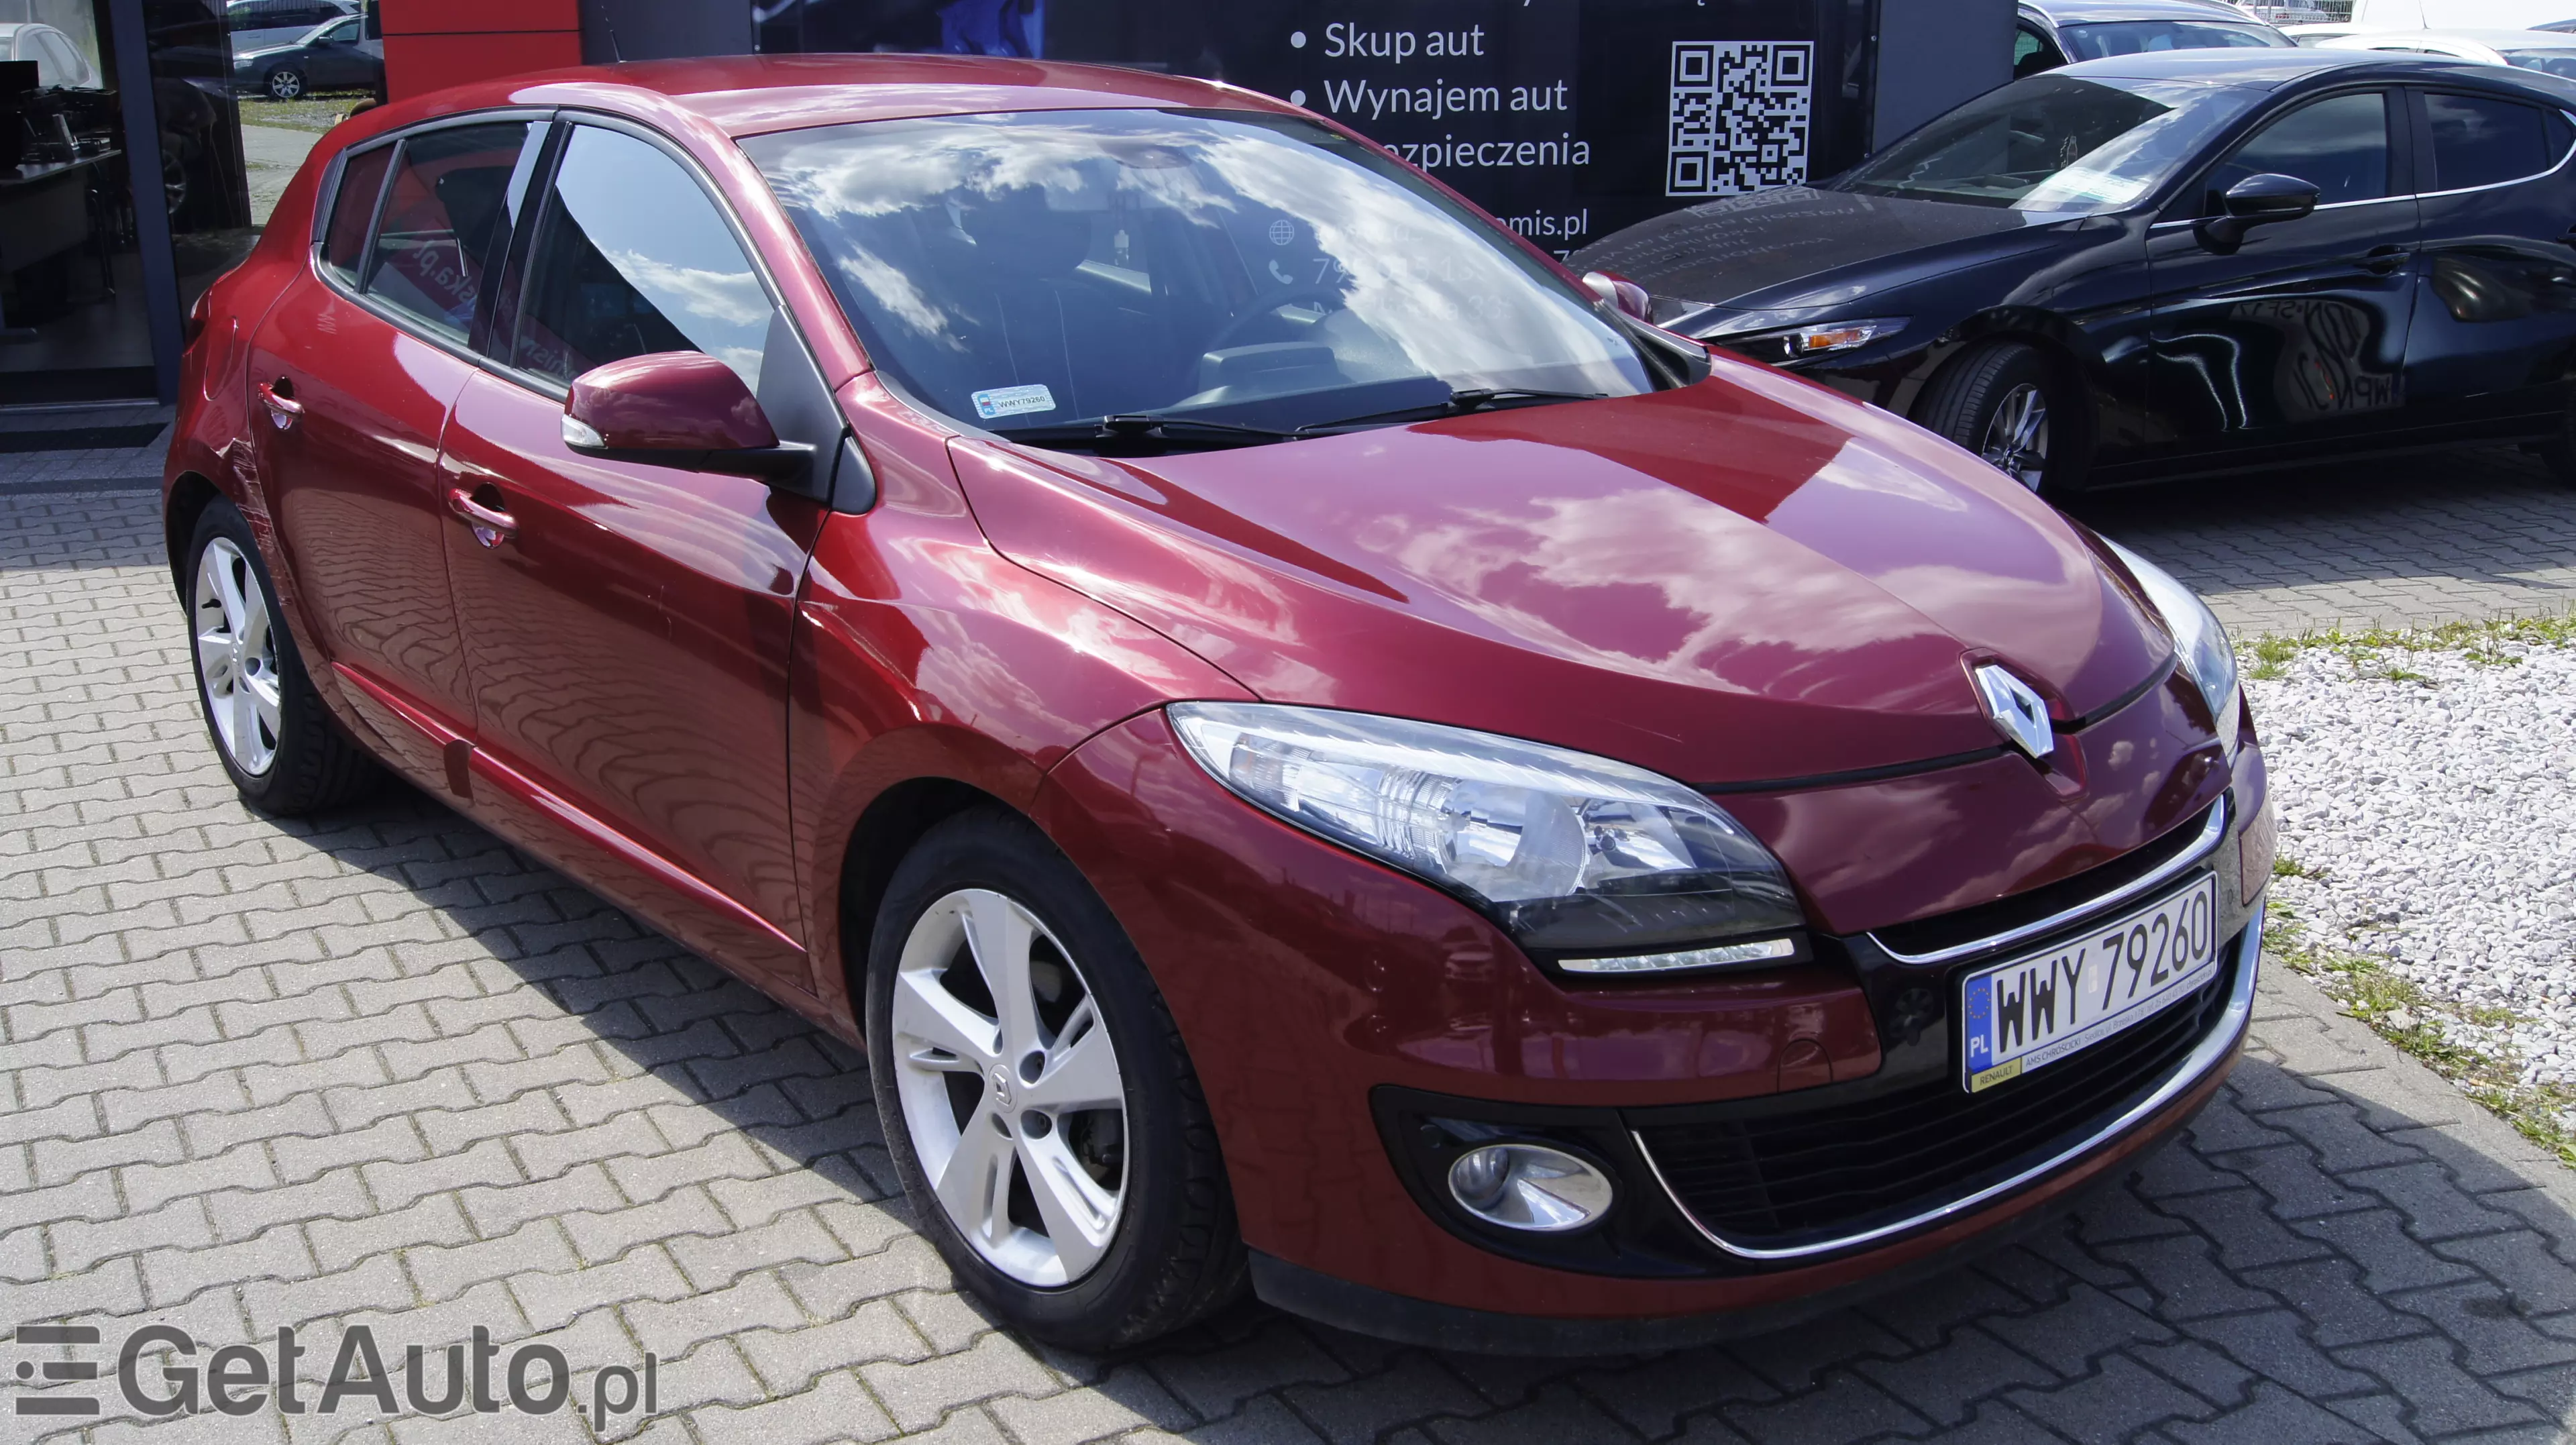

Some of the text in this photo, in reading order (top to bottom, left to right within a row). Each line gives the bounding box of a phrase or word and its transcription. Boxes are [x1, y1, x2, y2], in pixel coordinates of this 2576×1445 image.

[1324, 22, 1485, 64] Skup aut
[1323, 78, 1568, 120] Wynajem aut
[998, 396, 1046, 408] WWY79260
[1996, 891, 2208, 1053] WWY 79260
[1970, 1034, 1989, 1058] PL
[2025, 1055, 2041, 1067] AMS
[1980, 1065, 2014, 1086] RENAULT
